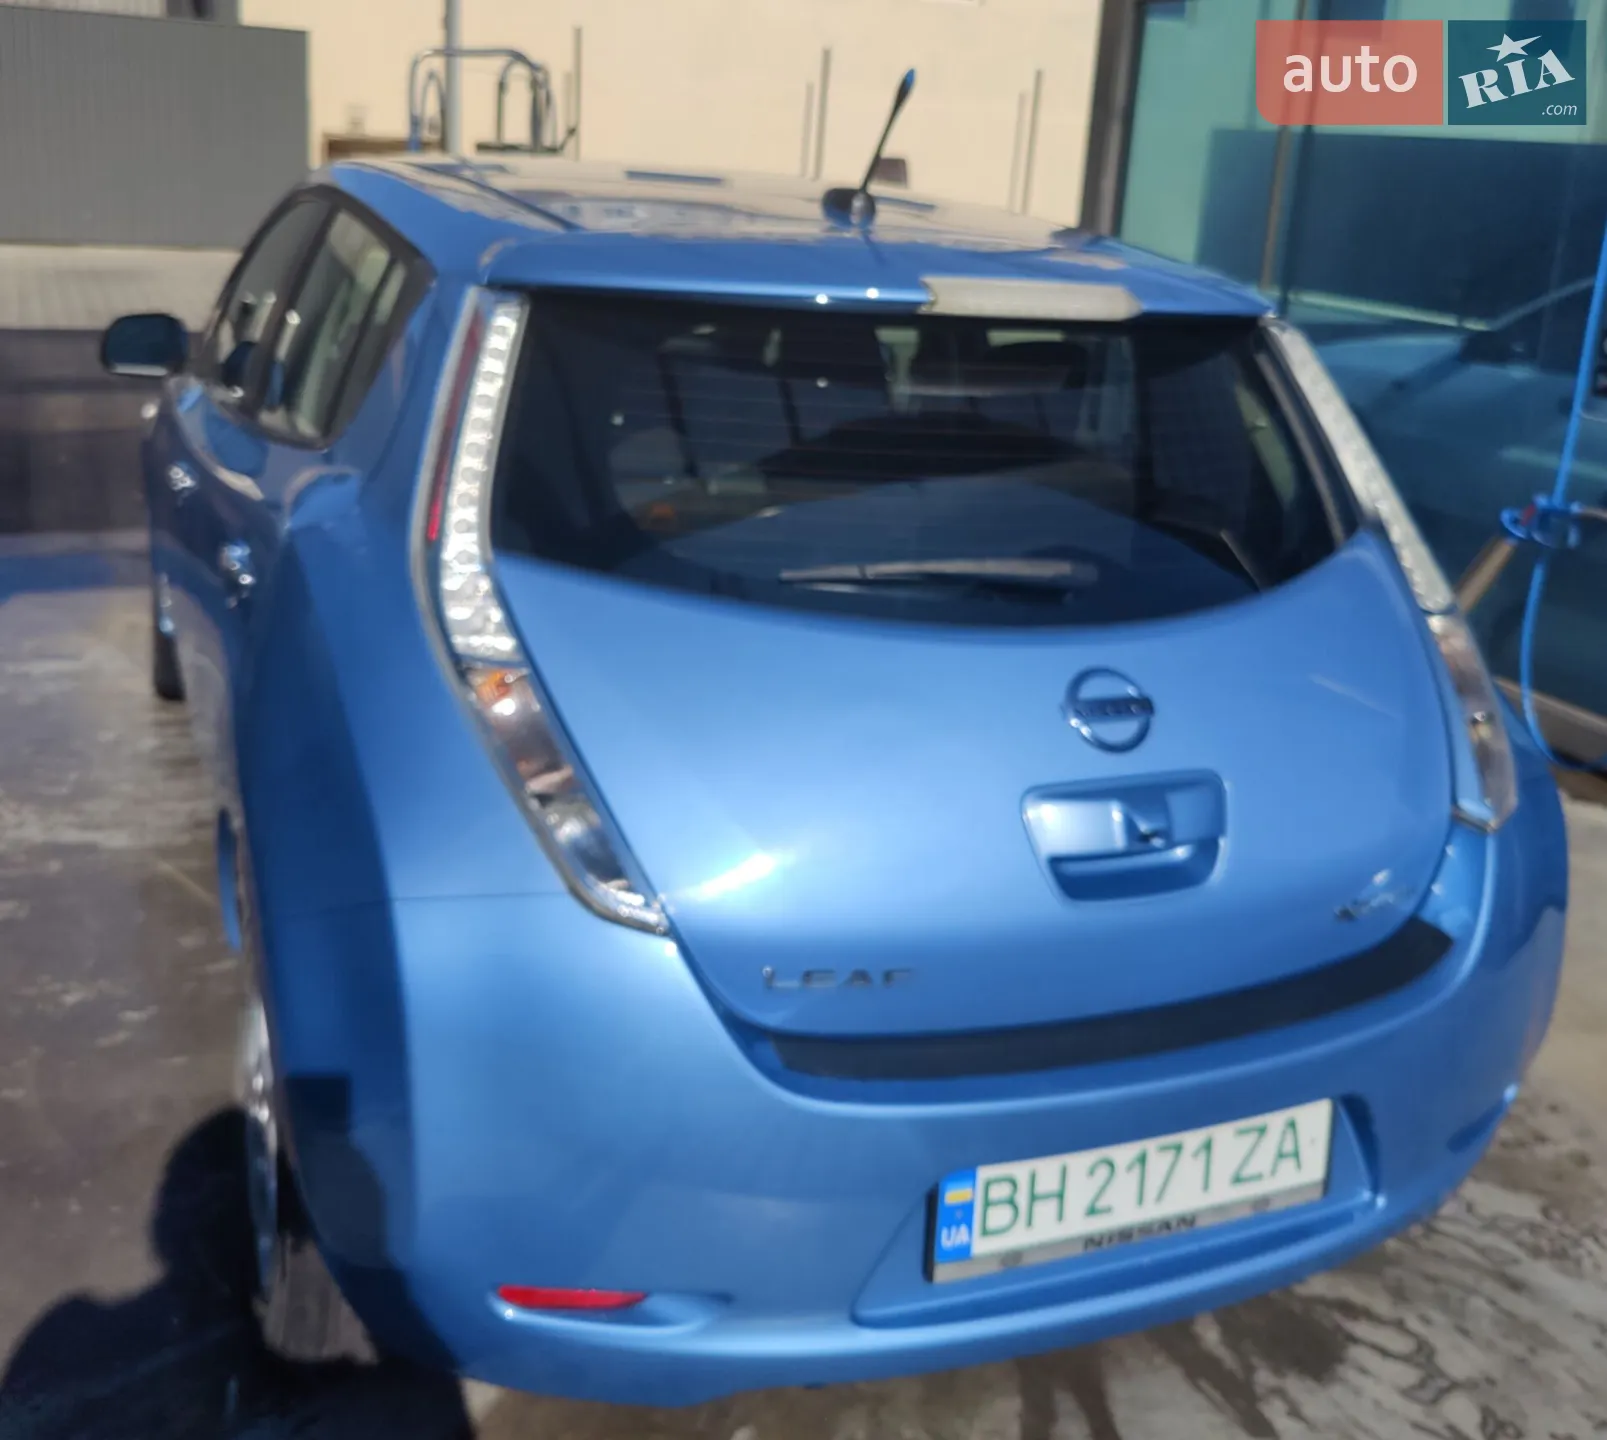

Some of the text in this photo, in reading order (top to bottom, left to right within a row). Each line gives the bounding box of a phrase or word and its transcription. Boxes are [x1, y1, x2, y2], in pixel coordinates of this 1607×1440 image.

[761, 965, 914, 992] LEAF
[979, 1116, 1302, 1238] BH 2171 ZA
[940, 1222, 971, 1250] UA
